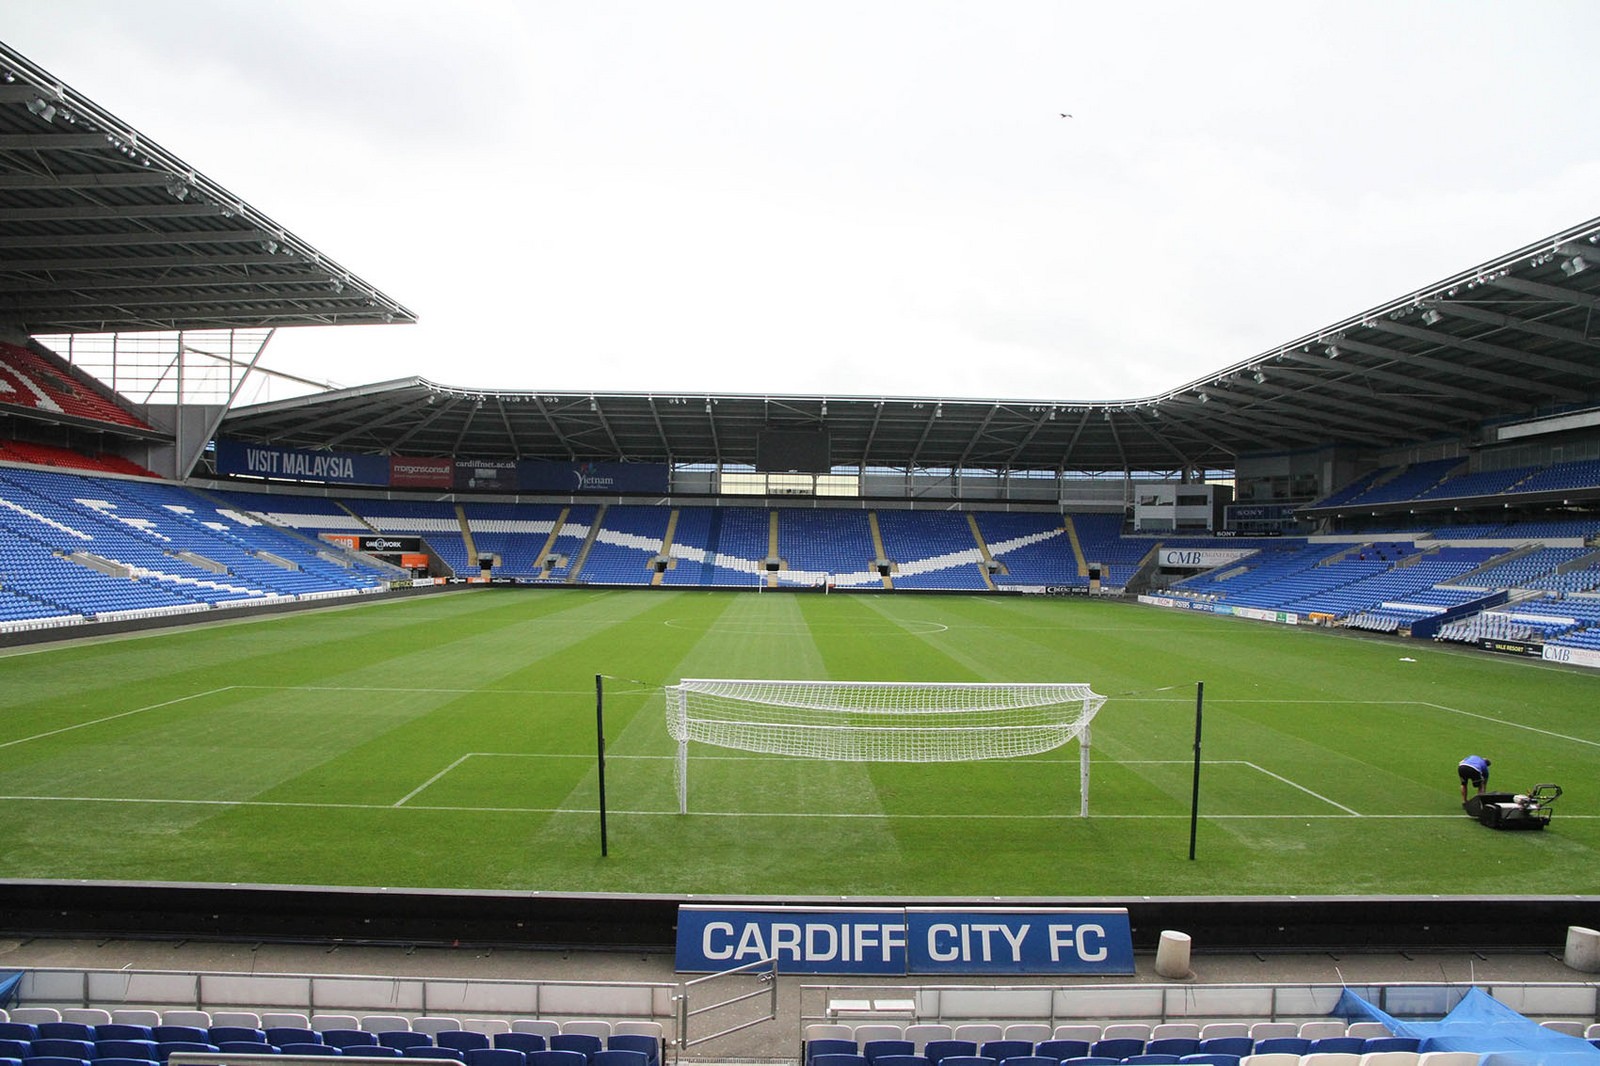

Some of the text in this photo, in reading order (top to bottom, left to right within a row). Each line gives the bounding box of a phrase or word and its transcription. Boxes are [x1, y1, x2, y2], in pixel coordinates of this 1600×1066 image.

[247, 449, 354, 478] VISIT MALAYSIA
[572, 470, 614, 490] Vietnam
[1167, 551, 1201, 564] CMB
[1545, 646, 1570, 661] CMB
[703, 922, 1107, 962] CARDIFF CITY FC
